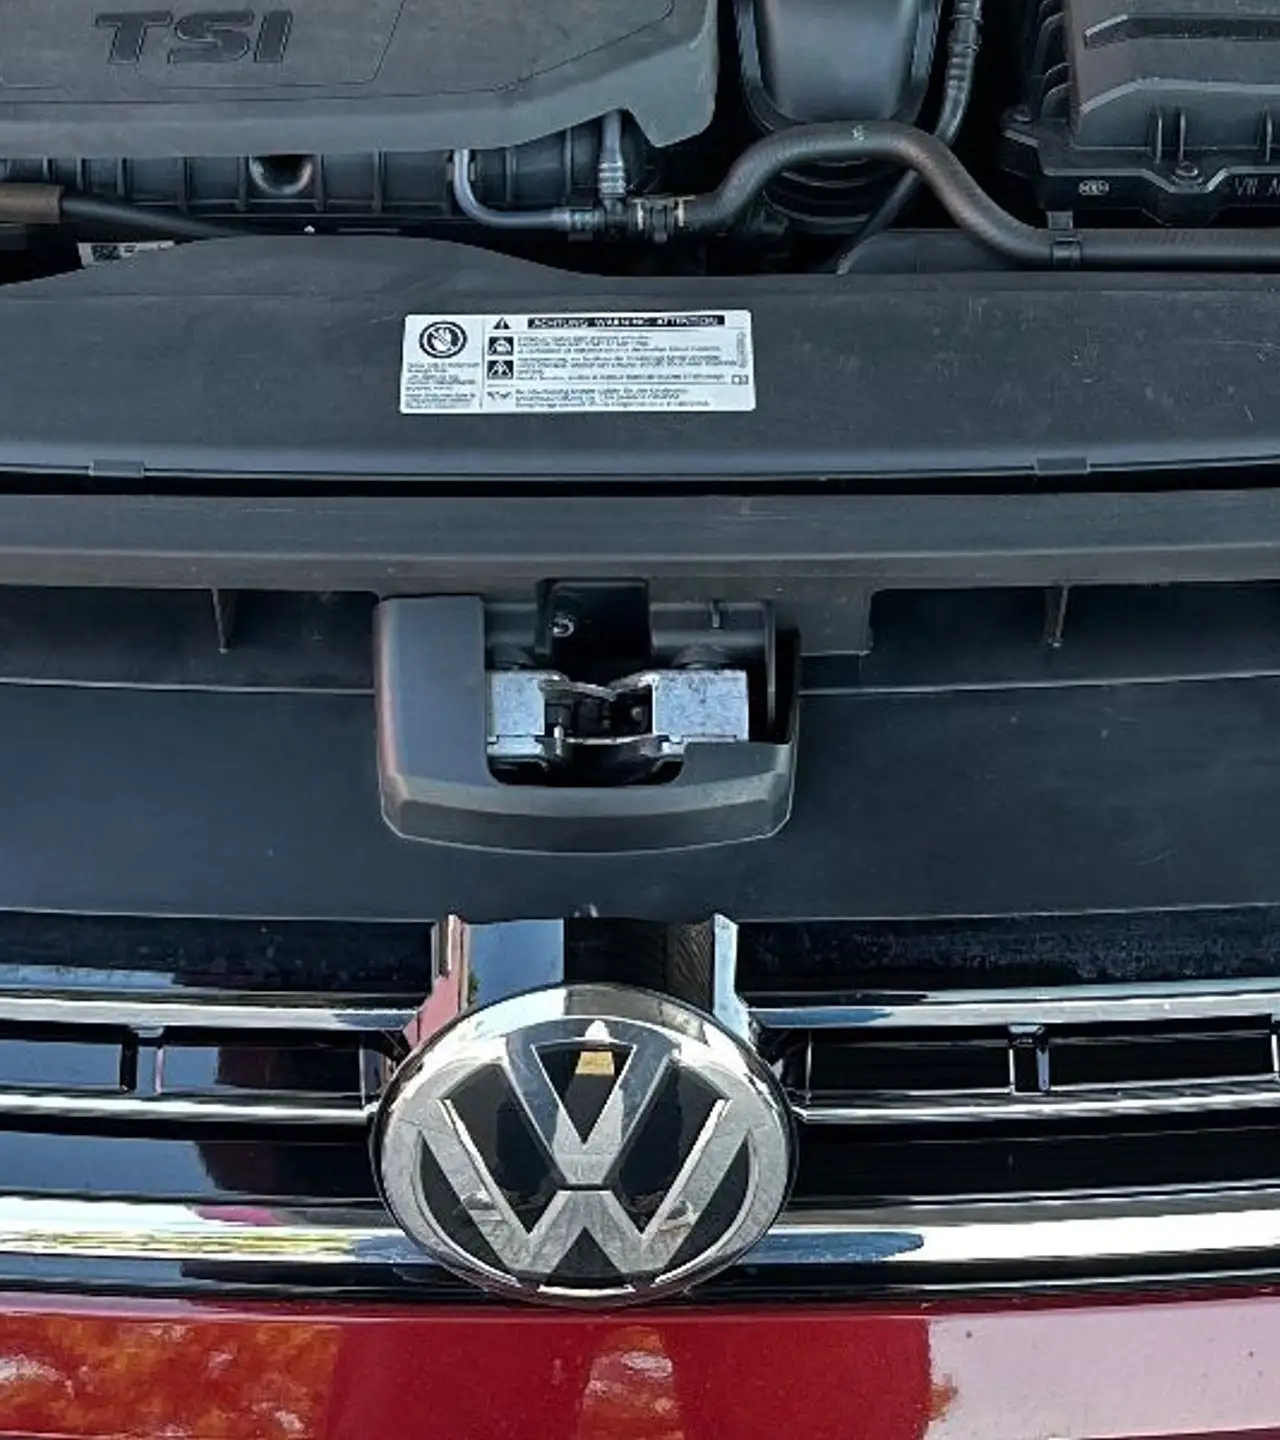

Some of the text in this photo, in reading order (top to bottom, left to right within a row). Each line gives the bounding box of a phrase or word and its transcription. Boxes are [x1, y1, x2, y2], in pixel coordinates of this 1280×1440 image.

[95, 11, 294, 63] TSI
[531, 315, 718, 329] ACHTUNG WARNING ATTENTION
[405, 1010, 765, 1285] VW
